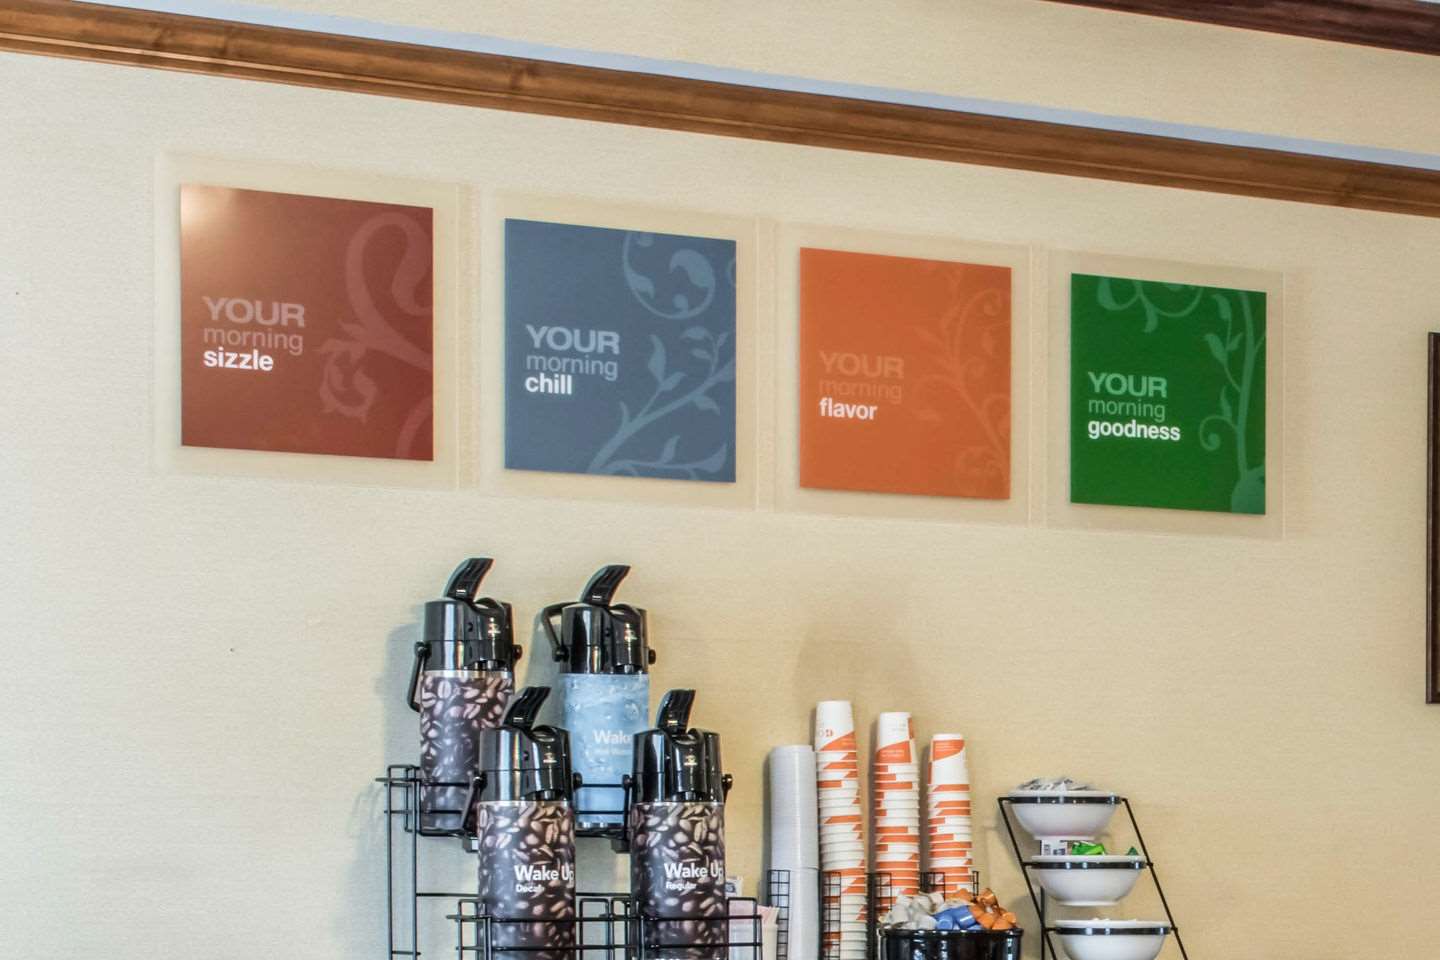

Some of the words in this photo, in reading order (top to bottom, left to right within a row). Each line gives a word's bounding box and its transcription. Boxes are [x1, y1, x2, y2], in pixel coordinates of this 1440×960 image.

[202, 296, 305, 327] YOUR
[204, 328, 303, 356] morning
[526, 324, 620, 354] YOUR
[203, 346, 274, 371] sizzle
[526, 354, 618, 381] morning
[819, 350, 904, 379] YOUR
[525, 372, 572, 395] chill
[819, 380, 902, 405] morning
[1088, 371, 1167, 398] YOUR
[819, 397, 878, 420] flavor
[1088, 399, 1166, 423] morning
[1088, 419, 1181, 441] goodness
[514, 865, 559, 881] Wake
[561, 863, 575, 888] Up
[664, 862, 708, 879] Wake
